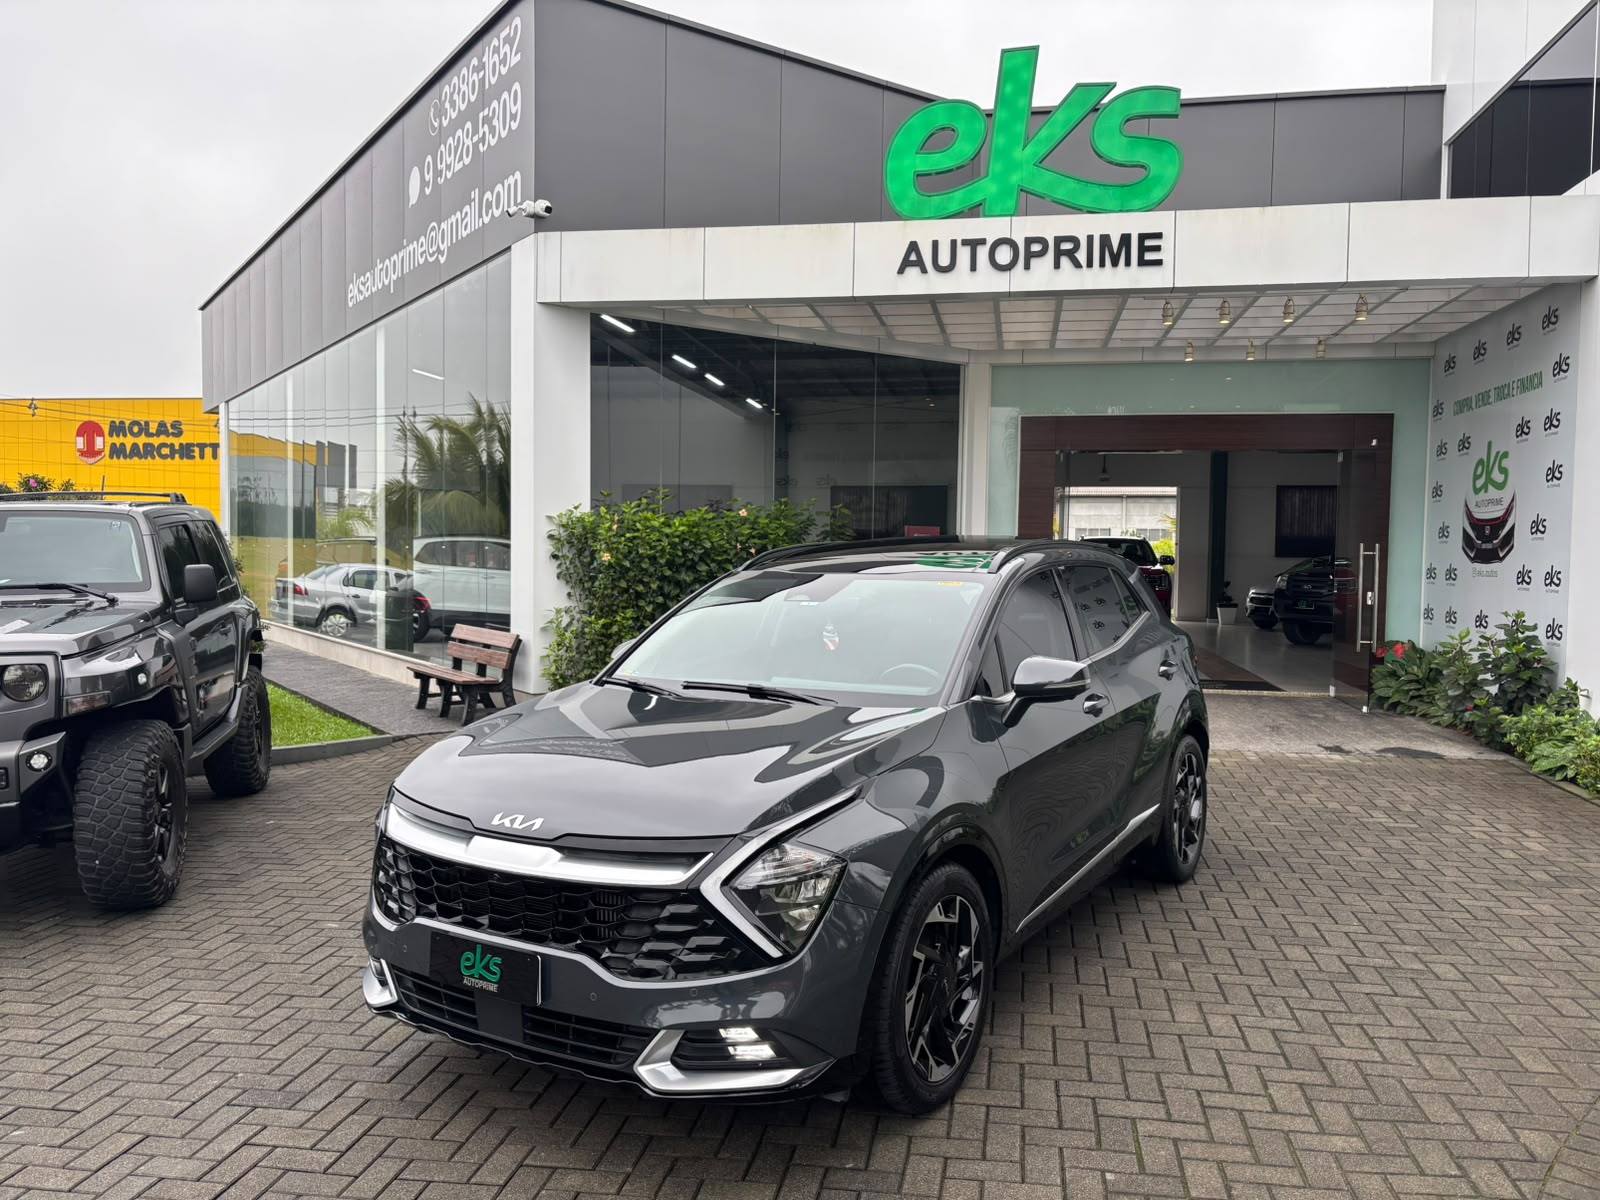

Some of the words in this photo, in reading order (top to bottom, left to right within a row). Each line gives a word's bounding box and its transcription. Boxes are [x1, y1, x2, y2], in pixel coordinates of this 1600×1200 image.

[441, 16, 522, 128] 3386-1652
[424, 154, 433, 195] 9
[437, 82, 522, 185] 9928-5309
[884, 45, 1184, 220] eks
[347, 170, 522, 308] eksautoprime@gmail.com
[897, 231, 1164, 275] AUTOPRIME
[108, 420, 184, 438] MOLAS
[108, 442, 220, 460] MARCHETT
[1472, 440, 1509, 495] eks
[1474, 497, 1504, 508] AUTOPRIME
[491, 812, 545, 831] KIA
[460, 944, 503, 983] eks
[463, 976, 498, 992] AUTOPRIME
